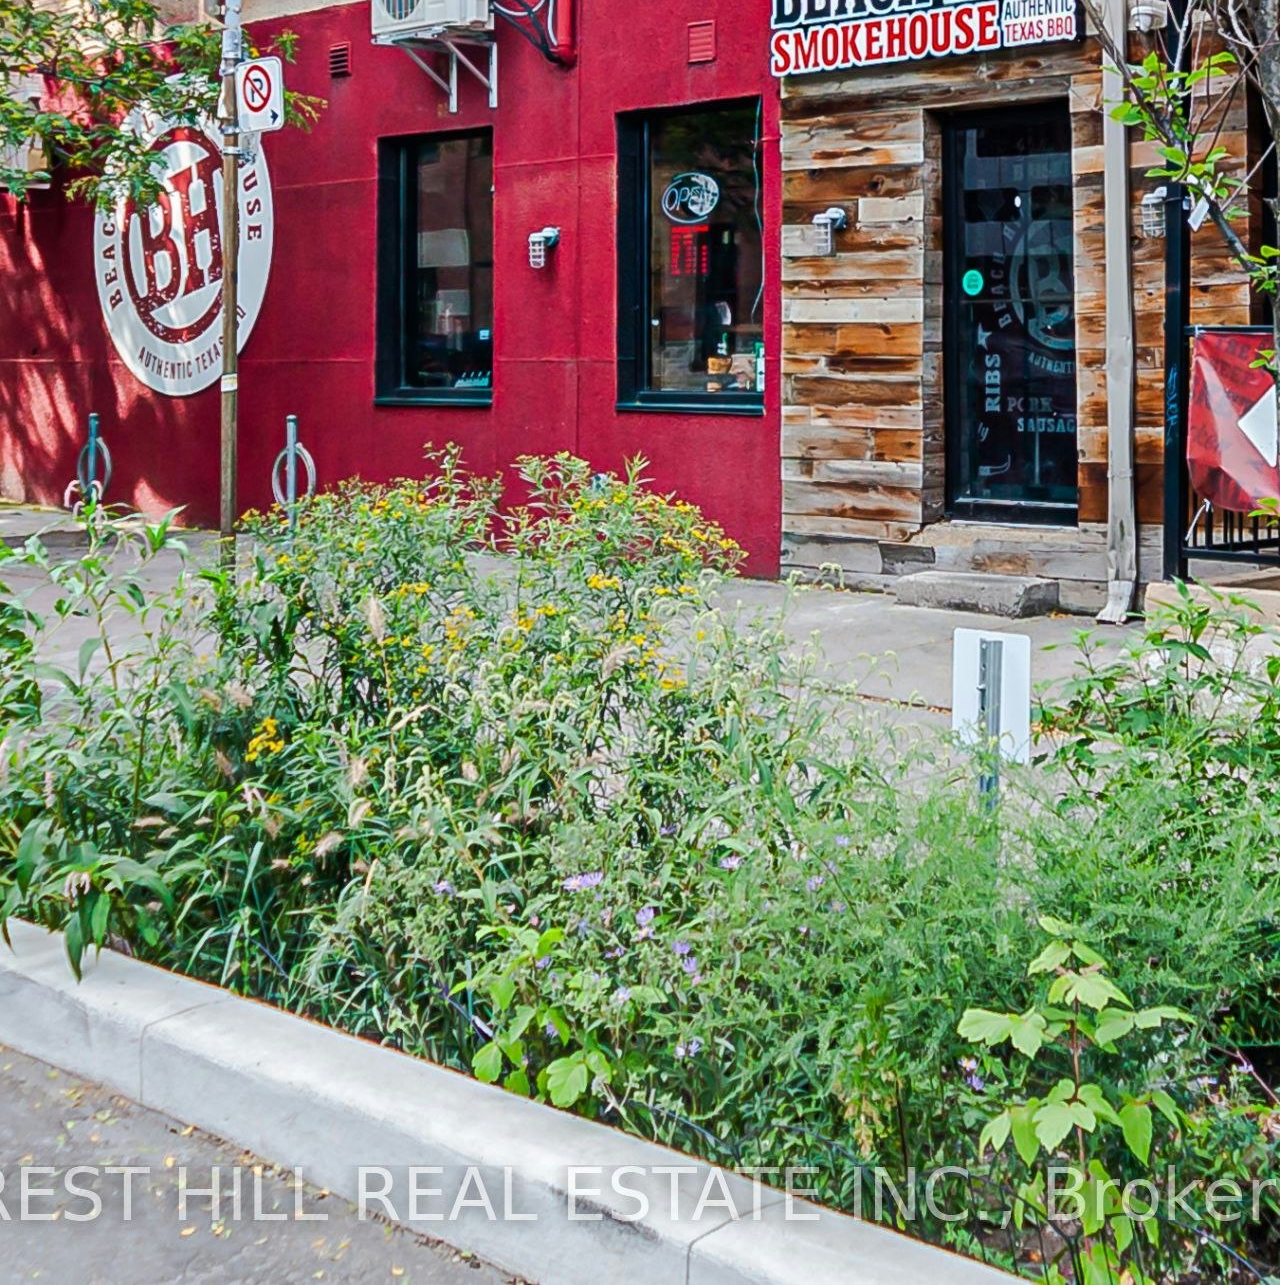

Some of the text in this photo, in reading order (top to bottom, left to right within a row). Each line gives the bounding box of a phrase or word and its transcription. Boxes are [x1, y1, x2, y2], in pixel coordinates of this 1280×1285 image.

[774, 5, 999, 73] SMOKEHOUSE
[1005, 13, 1074, 46] TEXAS BBQ
[138, 346, 193, 380] AUTHENTIC
[985, 353, 1001, 412] RIBS
